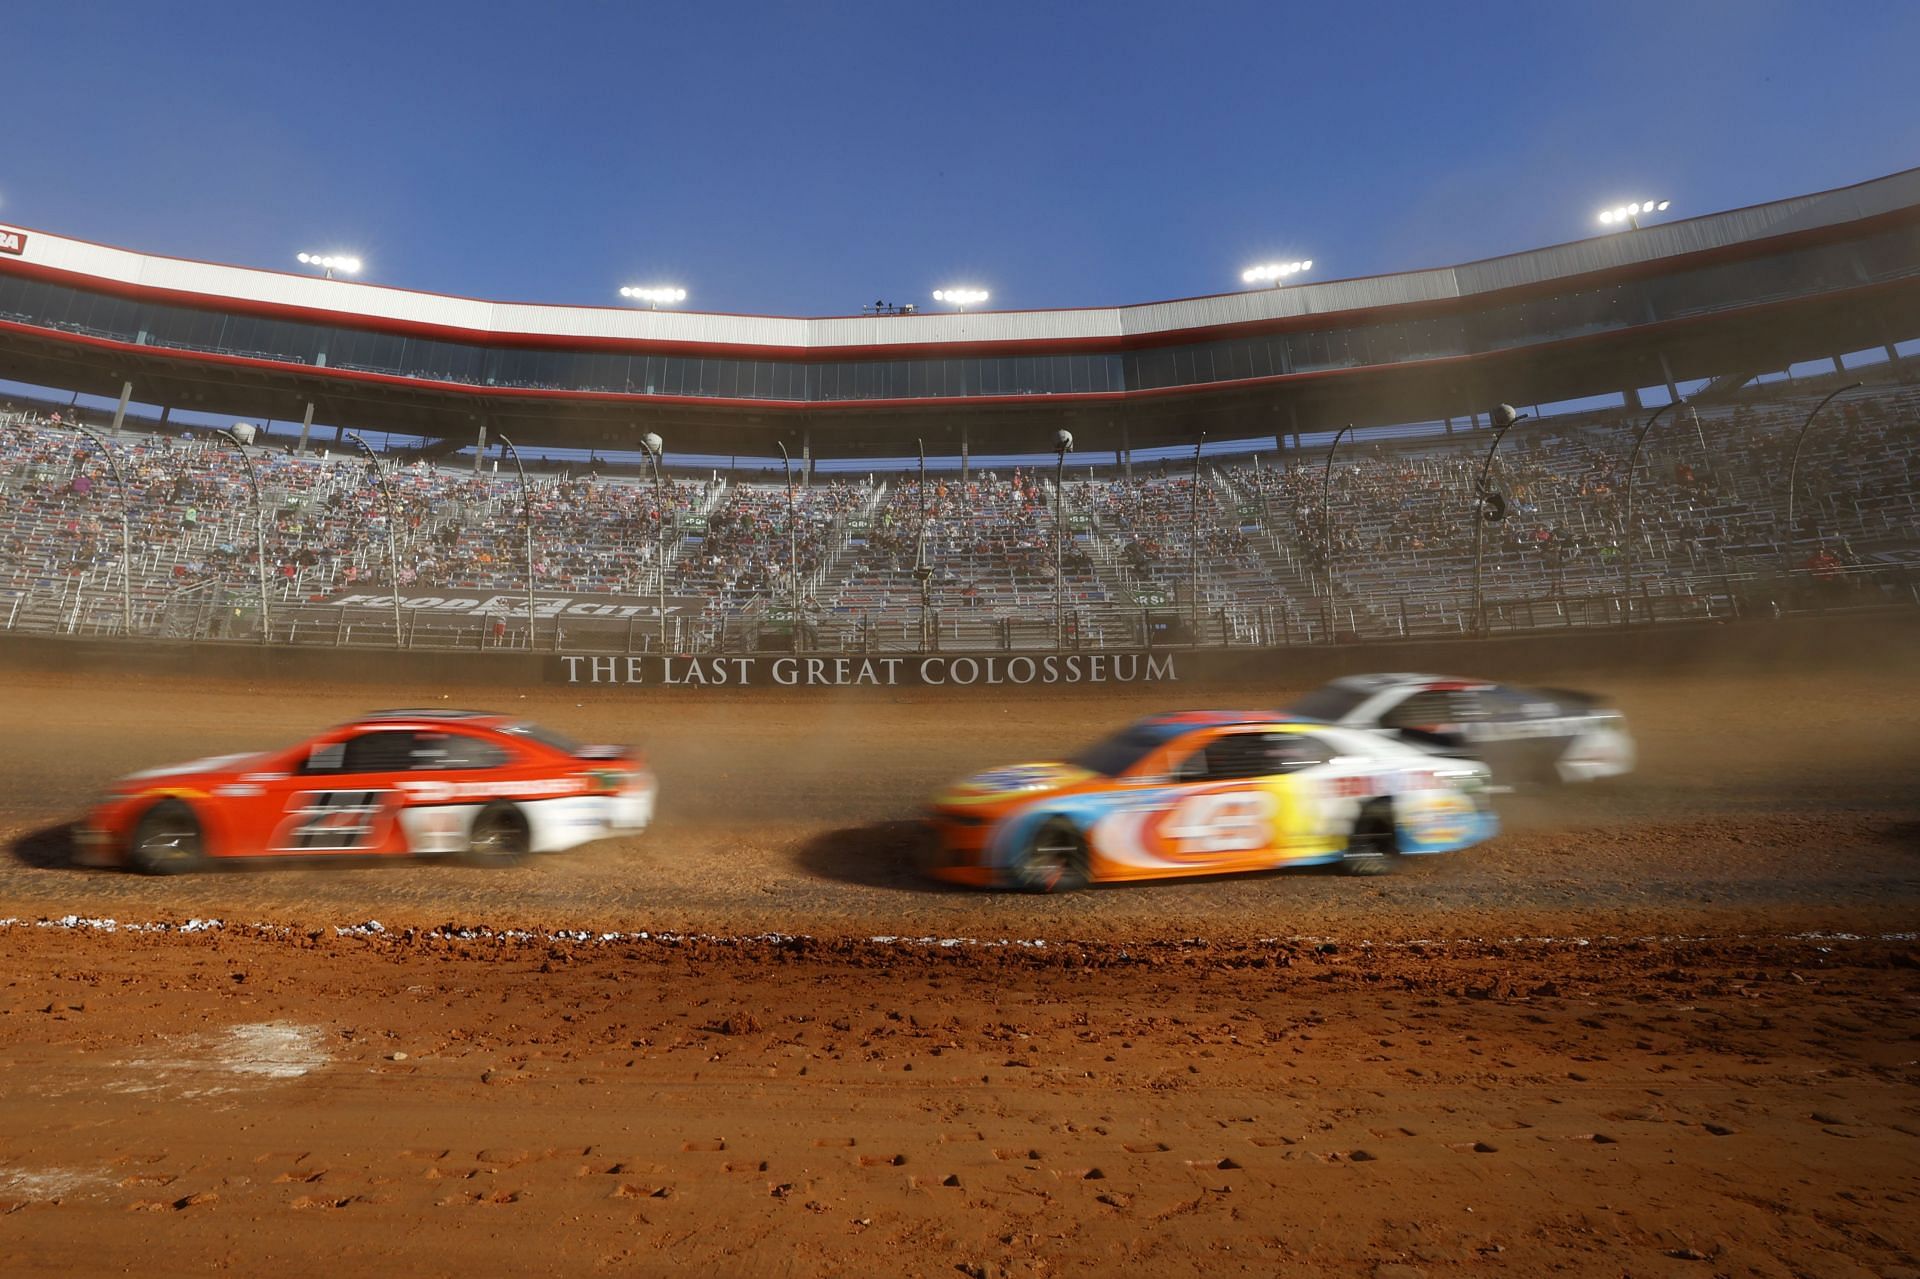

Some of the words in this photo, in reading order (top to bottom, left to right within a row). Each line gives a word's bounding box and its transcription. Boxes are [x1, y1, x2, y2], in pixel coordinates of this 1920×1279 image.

[330, 594, 480, 609] FOOD
[566, 603, 684, 618] CITY
[1139, 595, 1160, 606] RS
[561, 656, 643, 684] THE
[662, 657, 755, 685] LAST
[771, 657, 904, 685] GREAT
[920, 653, 1179, 685] COLOSSEUM
